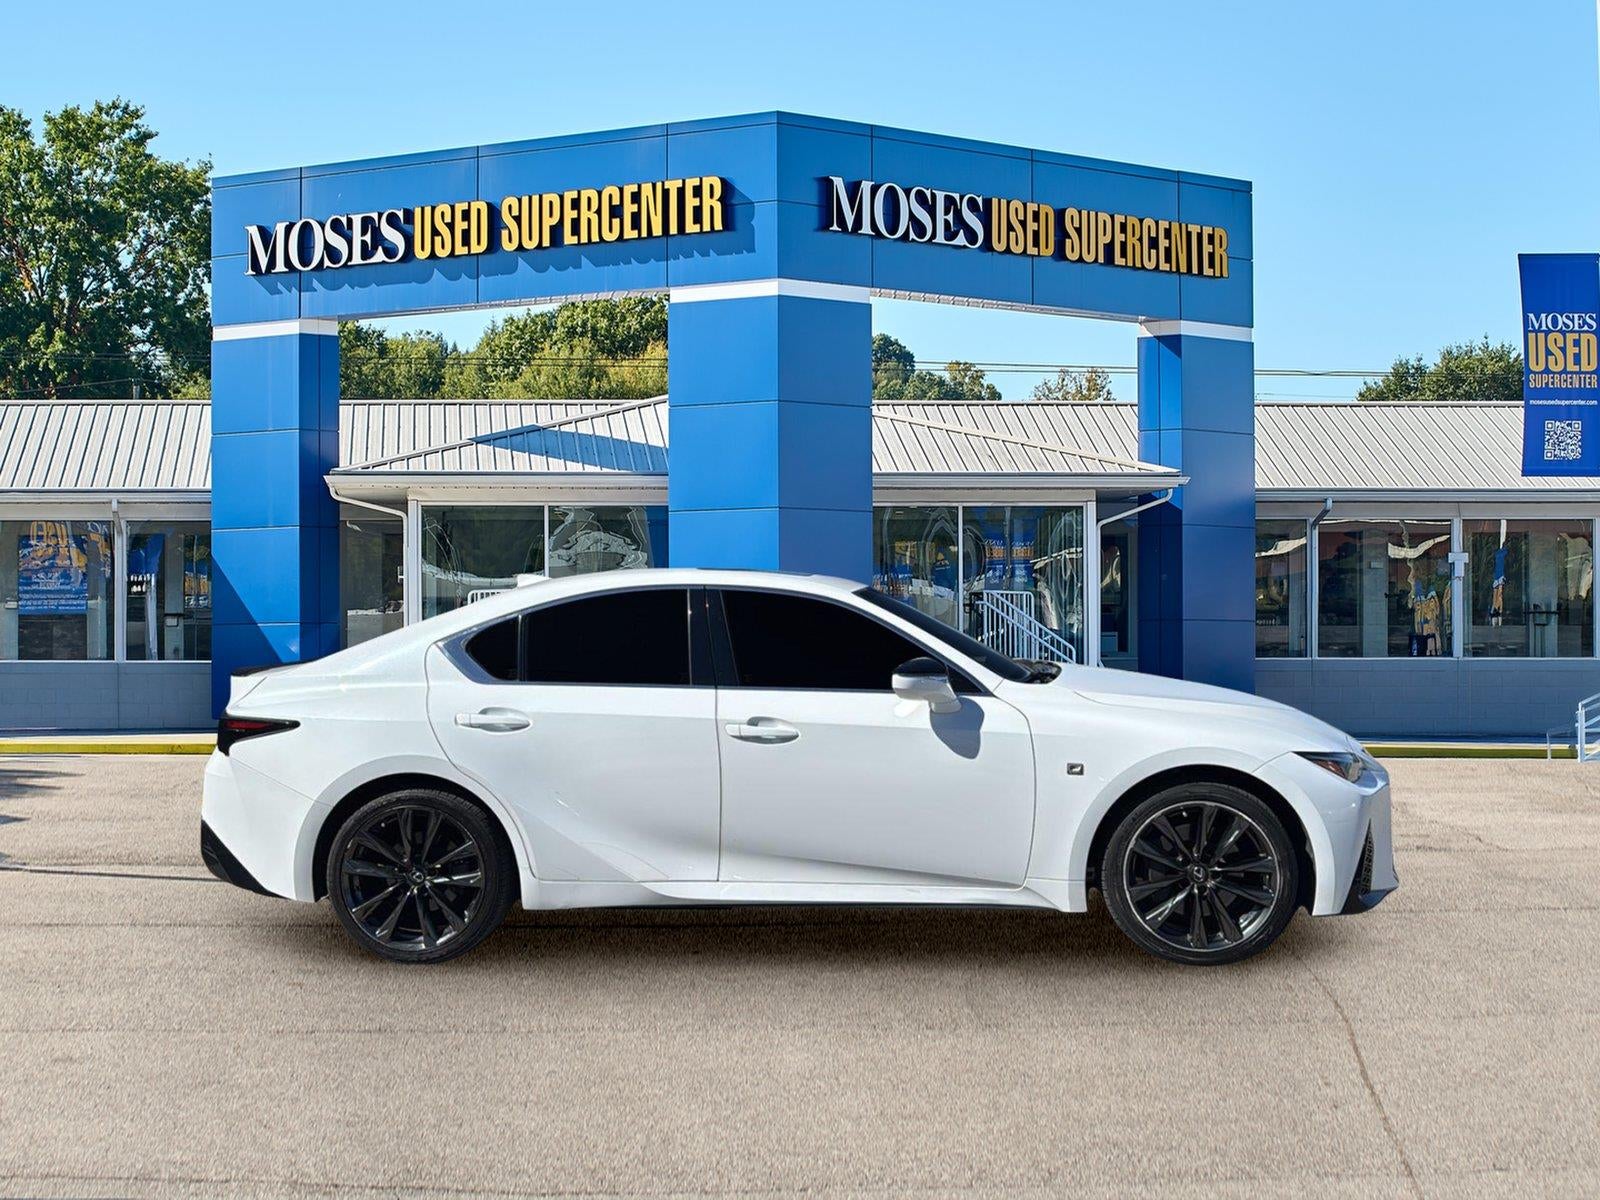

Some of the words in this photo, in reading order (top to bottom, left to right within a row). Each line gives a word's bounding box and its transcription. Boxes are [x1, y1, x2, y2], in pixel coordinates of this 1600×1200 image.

[244, 208, 407, 277] MOSES
[413, 200, 489, 260] USED
[500, 175, 724, 252] SUPERCENTER
[829, 175, 984, 249] MOSES
[990, 197, 1055, 258] USED
[1064, 206, 1230, 279] SUPERCENTER
[1527, 312, 1597, 331] MOSES
[1528, 332, 1598, 372] USED
[1529, 373, 1598, 388] SUPERCENTER
